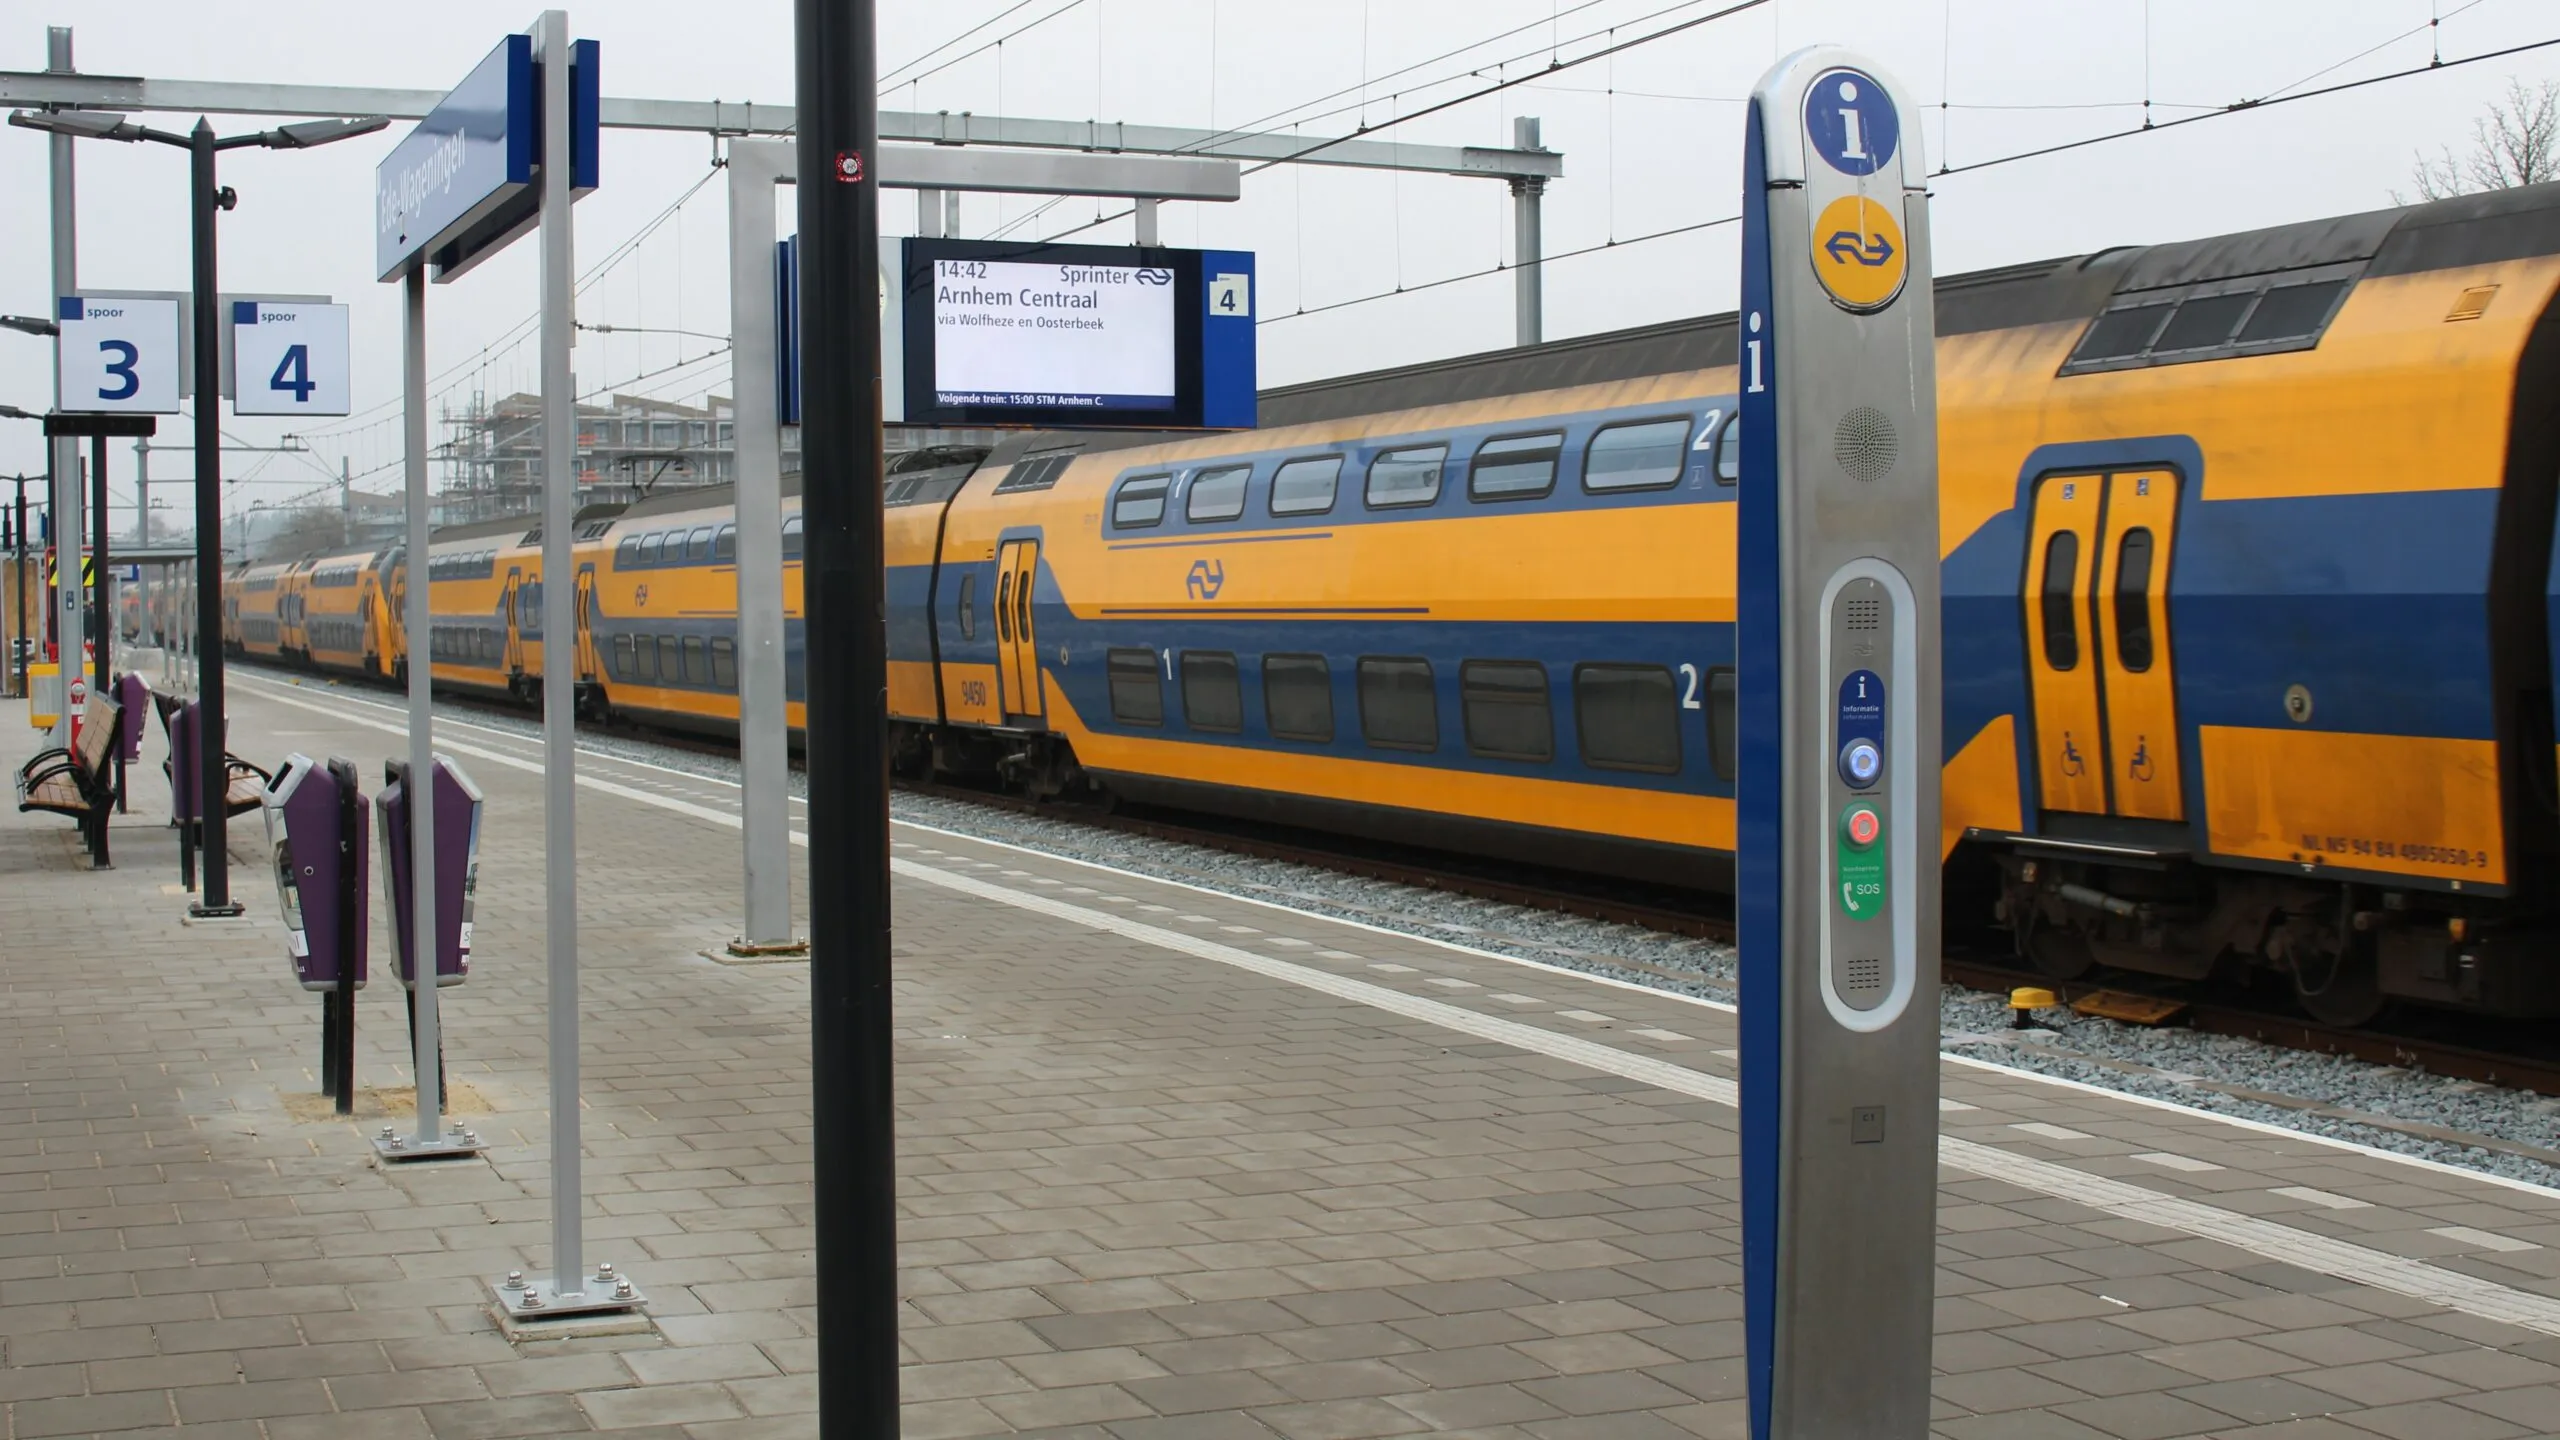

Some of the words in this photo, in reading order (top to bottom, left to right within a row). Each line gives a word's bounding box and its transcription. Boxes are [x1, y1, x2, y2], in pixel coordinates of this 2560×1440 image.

[381, 126, 466, 233] Ede-Wageningen
[939, 261, 987, 279] 14:42
[1060, 265, 1129, 287] Sprinter
[938, 286, 1012, 306] Arnhem
[1019, 288, 1098, 309] Centraal
[1220, 289, 1236, 311] 4
[87, 307, 124, 318] spoor
[261, 311, 297, 323] spoor
[938, 314, 956, 325] via
[959, 313, 1015, 327] Wolfheze
[1018, 319, 1033, 327] en
[1036, 317, 1104, 330] Oosterbeek
[98, 339, 140, 400] 3
[270, 344, 316, 402] 4
[938, 393, 980, 405] Volgende
[983, 394, 1007, 404] trein:
[1010, 394, 1034, 405] 15:00
[1036, 395, 1055, 405] STM
[1058, 396, 1092, 406] Arnhem
[1095, 396, 1104, 406] C.
[1692, 409, 1721, 450] 2
[1175, 469, 1189, 498] 1
[1163, 648, 1172, 681] 1
[1680, 663, 1701, 709] 2
[1843, 705, 1880, 713] Informatie
[2352, 838, 2371, 856] 94
[1856, 883, 1880, 895] SOS
